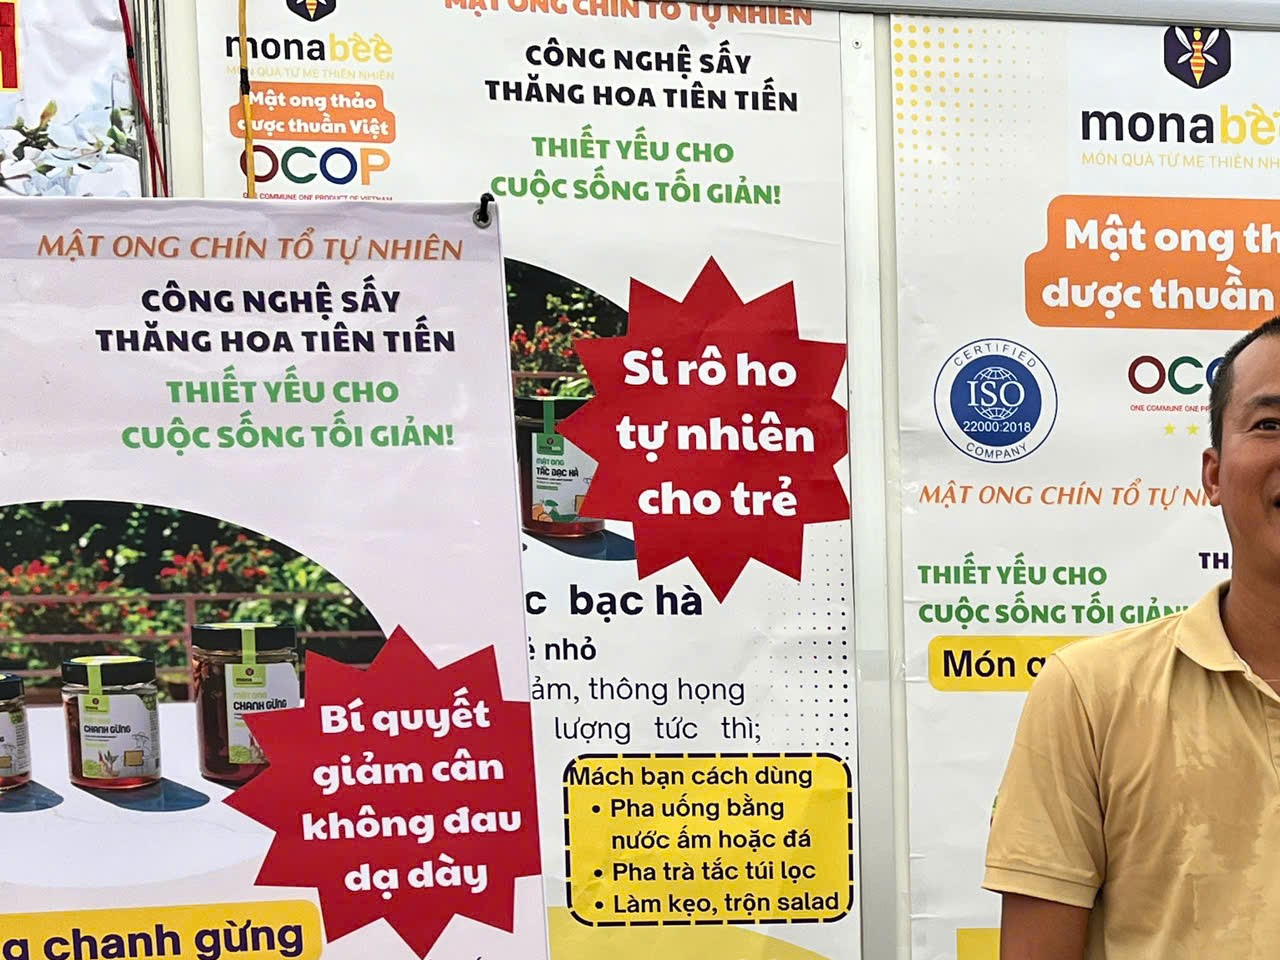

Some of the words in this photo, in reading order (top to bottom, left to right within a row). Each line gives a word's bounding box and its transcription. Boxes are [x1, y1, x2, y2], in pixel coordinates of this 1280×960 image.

[240, 146, 391, 186] OCOP
[38, 229, 104, 262] MẬT
[112, 235, 180, 260] ONG
[190, 230, 267, 261] CHÍN
[279, 226, 318, 261] TỔ
[324, 235, 363, 265] TỰ
[368, 231, 463, 262] NHIÊN
[1064, 214, 1146, 261] Mật
[1154, 229, 1234, 262] ong
[141, 280, 238, 313] CÔNG
[244, 281, 333, 320] NGHỆ
[342, 275, 401, 313] SẤY
[1042, 277, 1142, 319] dược
[1149, 264, 1274, 312] thuần
[95, 321, 212, 353] THĂNG
[221, 331, 294, 354] HOA
[302, 321, 374, 353] TIÊN
[382, 315, 455, 352] TIẾN
[623, 347, 668, 386] Si
[678, 345, 727, 386] rô
[737, 352, 797, 387] ho
[953, 342, 1037, 368] CERTIFIED
[166, 365, 257, 403] THIẾT
[264, 366, 325, 403] YẾU
[333, 380, 399, 403] CHO
[966, 379, 1025, 407] ISO
[121, 417, 212, 457] CUỘC
[219, 410, 305, 448] SỐNG
[311, 410, 364, 447] TỐI
[370, 416, 454, 446] GIẢN!
[616, 415, 668, 463] tự
[678, 411, 815, 453] nhiên
[963, 420, 1031, 433] 22000:2018
[966, 442, 1028, 460] COMPANY
[638, 481, 721, 515] cho
[730, 475, 798, 516] trẻ
[570, 584, 644, 624] bạc
[656, 585, 703, 616] hà
[588, 677, 669, 706] thông
[678, 677, 745, 706] họng
[321, 698, 365, 734] Bí
[373, 687, 490, 739] quyết
[554, 717, 632, 745] lượng
[654, 717, 698, 740] tức
[721, 716, 762, 743] thì;
[313, 754, 424, 795] giảm
[432, 748, 504, 781] cân
[569, 766, 634, 786] Mách
[641, 767, 684, 790] bạn
[692, 766, 748, 785] cách
[755, 765, 813, 788] dùng
[303, 806, 435, 843] không
[444, 806, 521, 834] đau
[611, 799, 655, 818] Pha
[661, 794, 720, 822] uống
[727, 793, 784, 821] bằng
[612, 829, 670, 849] nước
[677, 824, 711, 849] ấm
[718, 829, 776, 854] hoặc
[782, 829, 812, 848] đá
[344, 865, 399, 900] dạ
[408, 853, 488, 893] dày
[613, 862, 656, 881] Pha
[663, 861, 695, 881] trà
[701, 859, 738, 880] tắc
[745, 861, 774, 880] túi
[781, 860, 816, 884] lọc
[613, 895, 661, 913] Làm
[668, 895, 719, 918] kẹo,
[724, 892, 773, 917] trộn
[777, 892, 839, 912] salad
